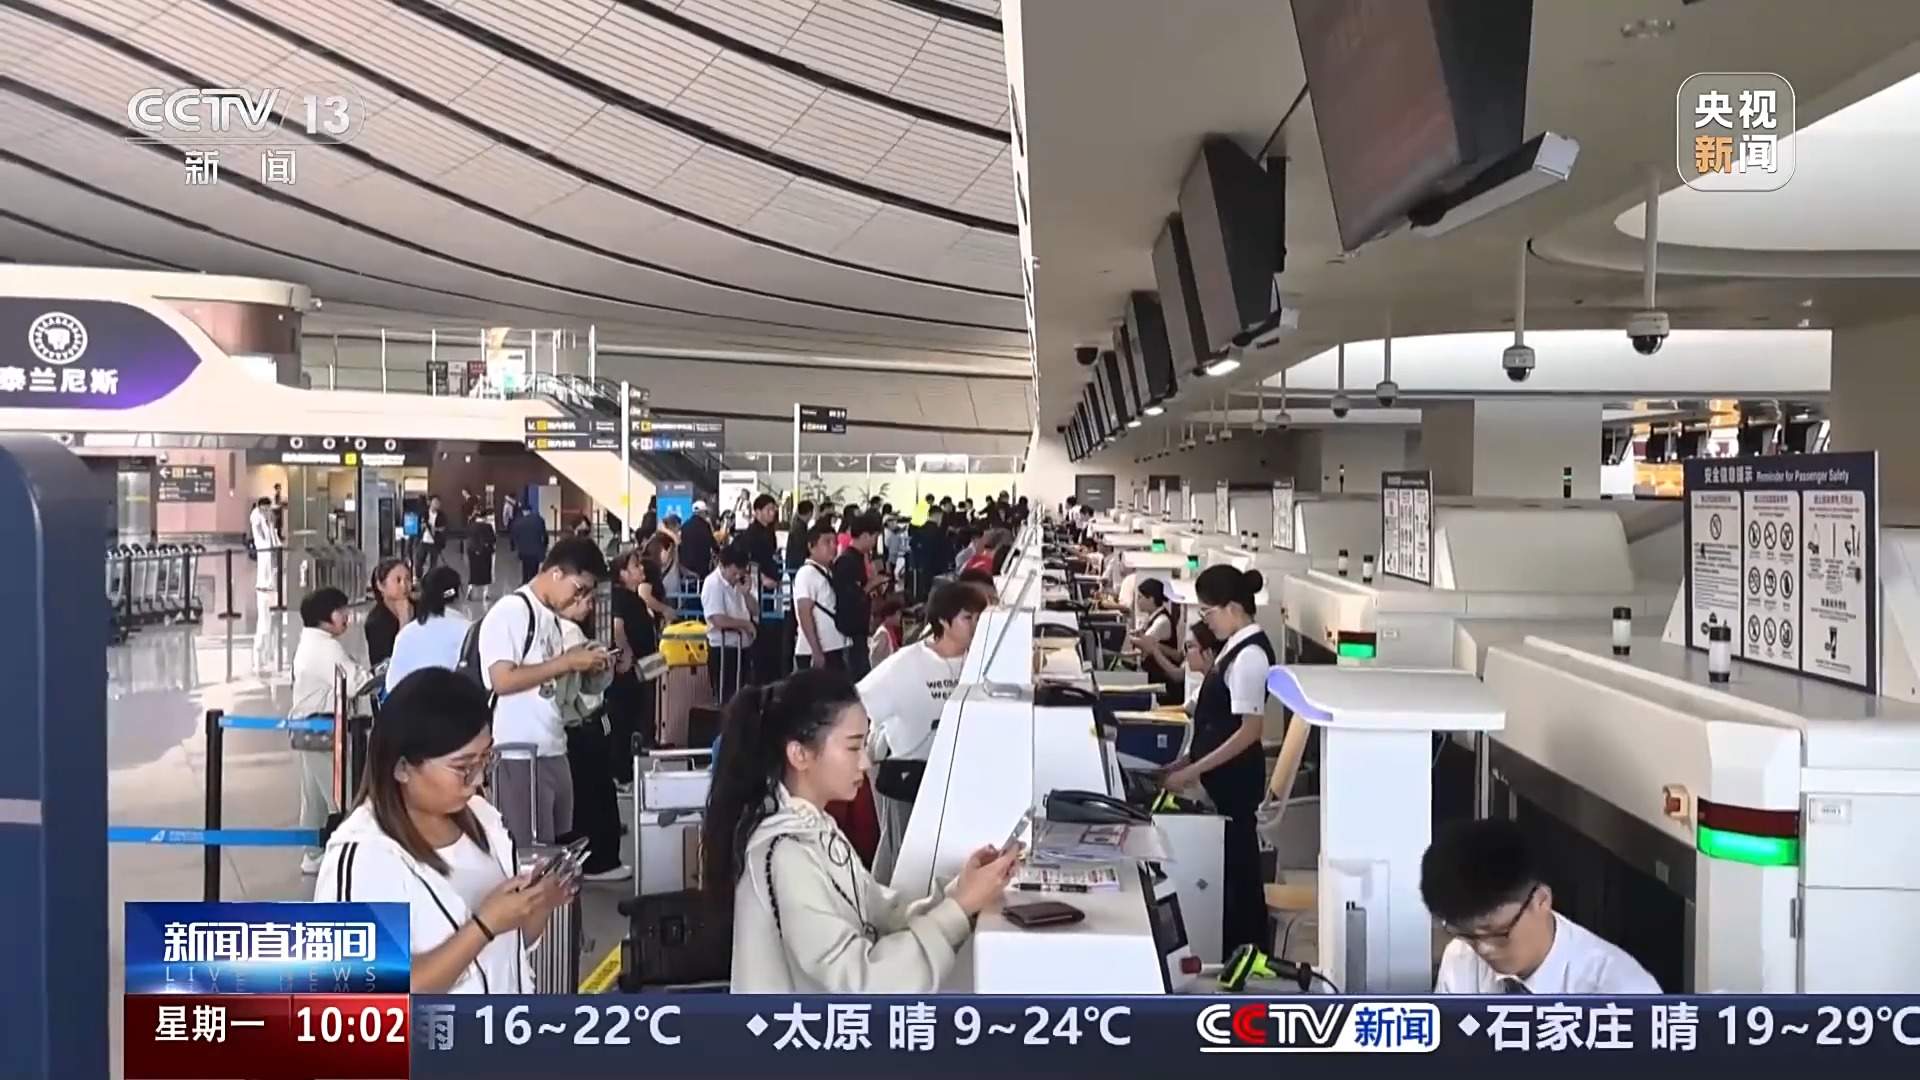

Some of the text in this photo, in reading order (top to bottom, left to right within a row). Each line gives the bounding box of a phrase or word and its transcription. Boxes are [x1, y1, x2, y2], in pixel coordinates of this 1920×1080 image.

[0, 366, 119, 395] 泰兰尼斯
[1794, 469, 1828, 485] Passenger
[1828, 468, 1849, 485] Safety
